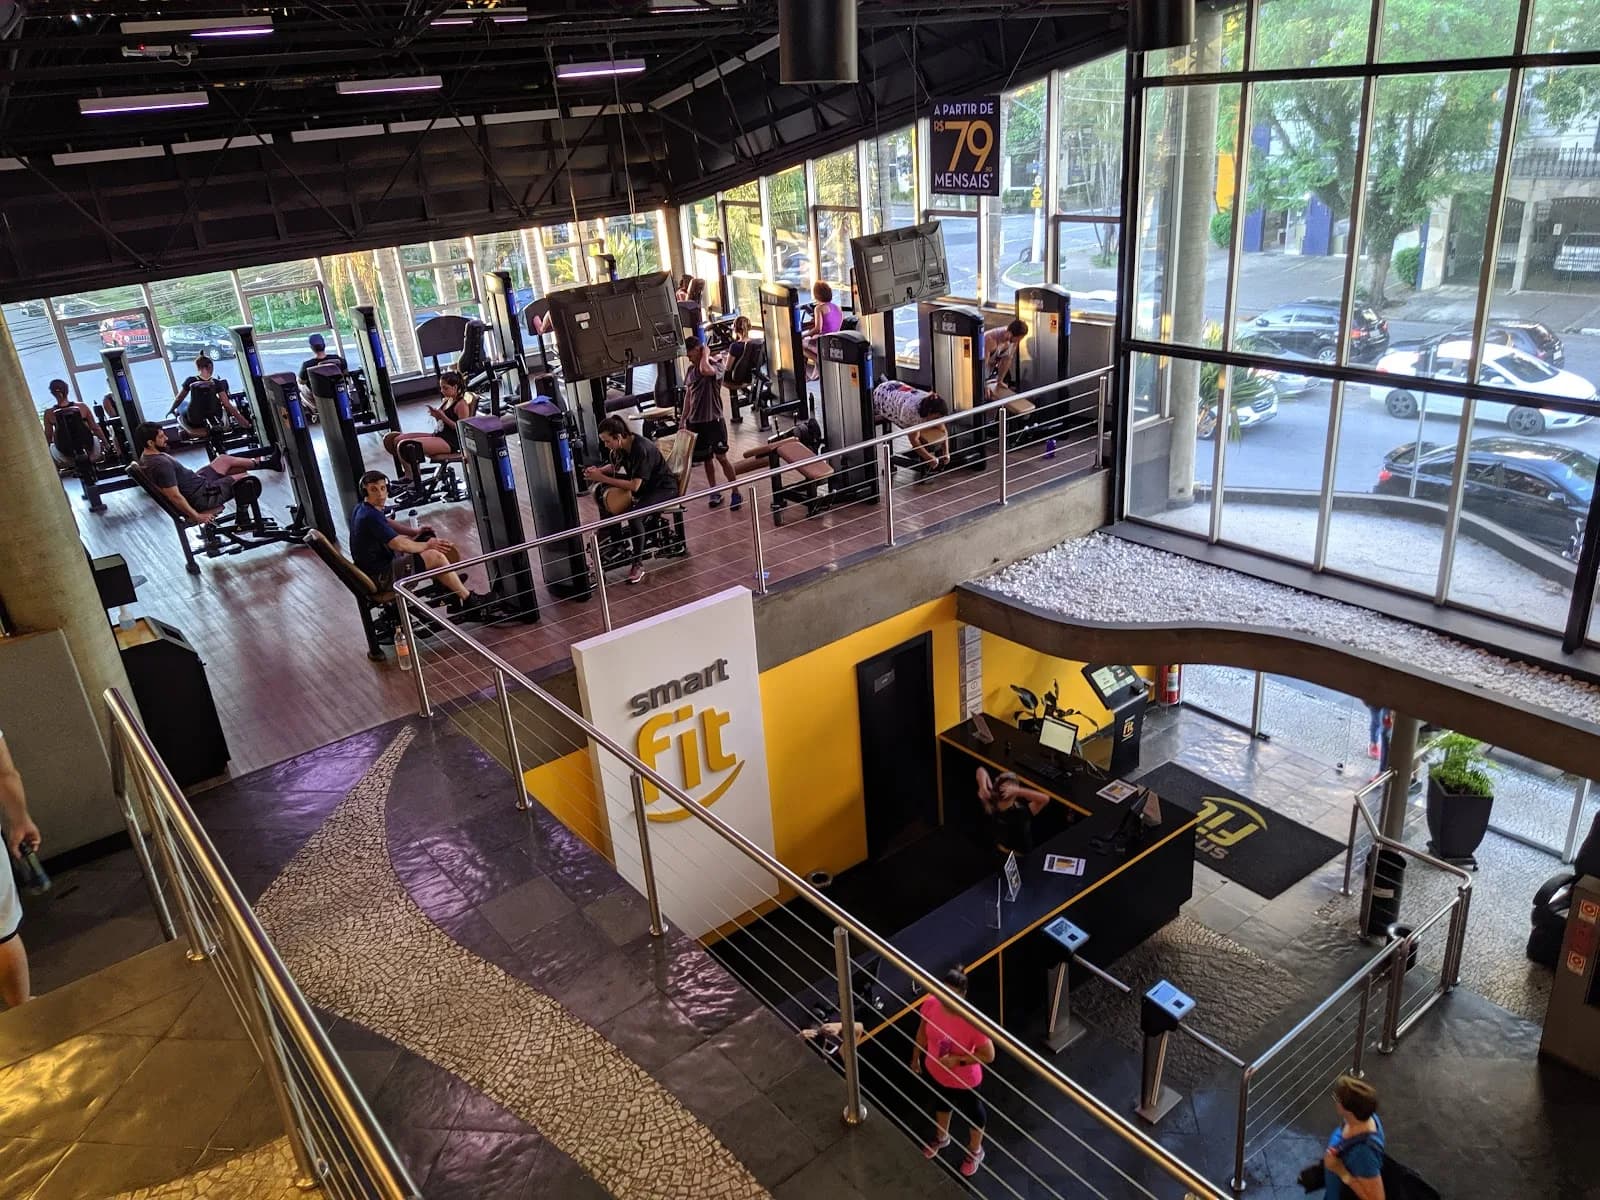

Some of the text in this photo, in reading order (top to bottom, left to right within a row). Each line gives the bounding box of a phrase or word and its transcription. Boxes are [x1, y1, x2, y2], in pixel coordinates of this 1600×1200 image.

[934, 102, 994, 115] A PARTIR DE
[945, 120, 993, 172] 79
[630, 658, 730, 717] smart
[637, 705, 737, 806] fit
